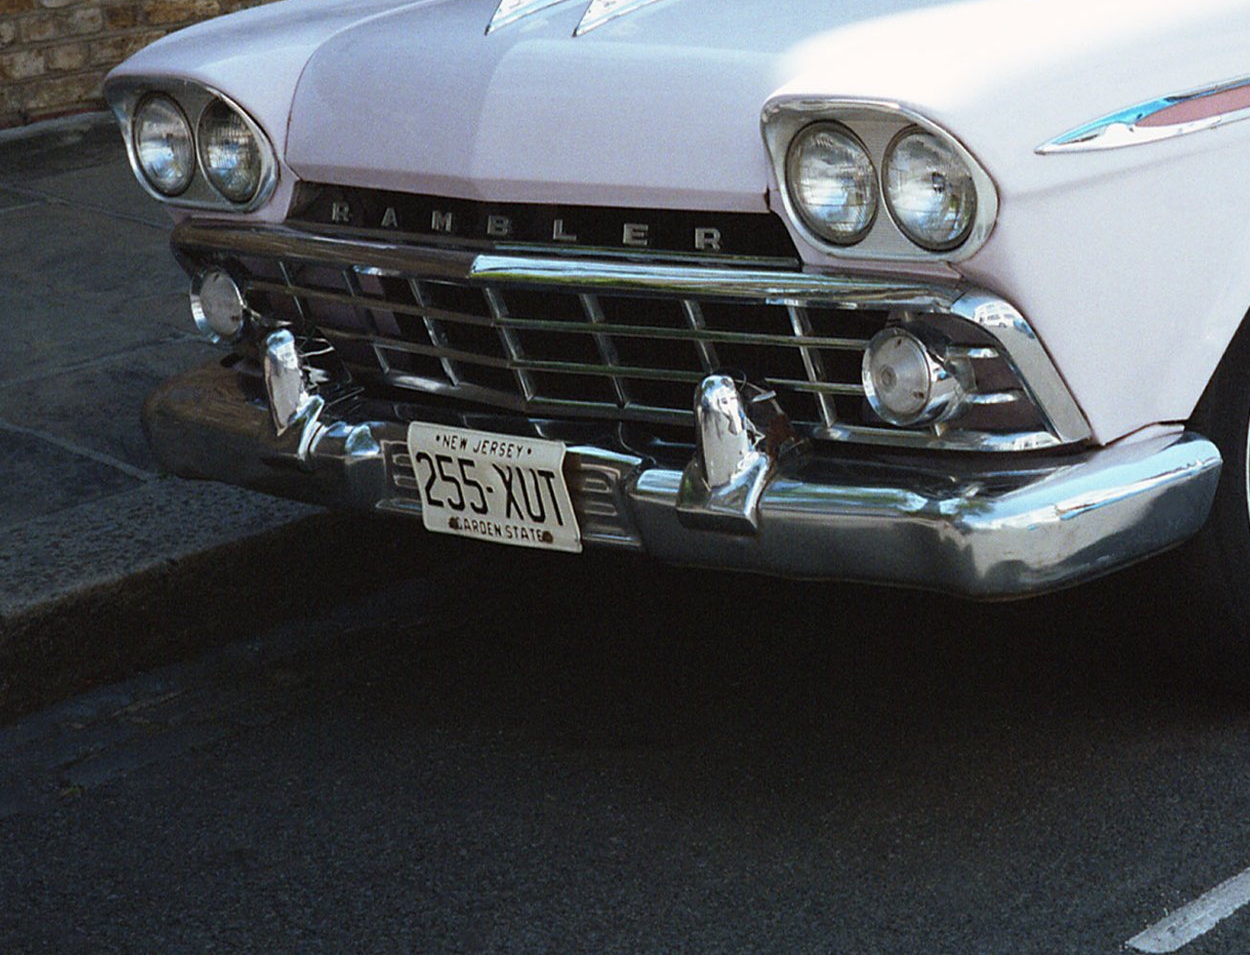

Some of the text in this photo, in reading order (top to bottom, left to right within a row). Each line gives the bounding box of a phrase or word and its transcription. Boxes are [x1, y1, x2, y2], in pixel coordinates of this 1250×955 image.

[331, 201, 722, 251] RAMBLER
[442, 434, 524, 459] NEW JERSEY
[415, 451, 564, 527] 255-XUT
[507, 526, 544, 544] STATE
